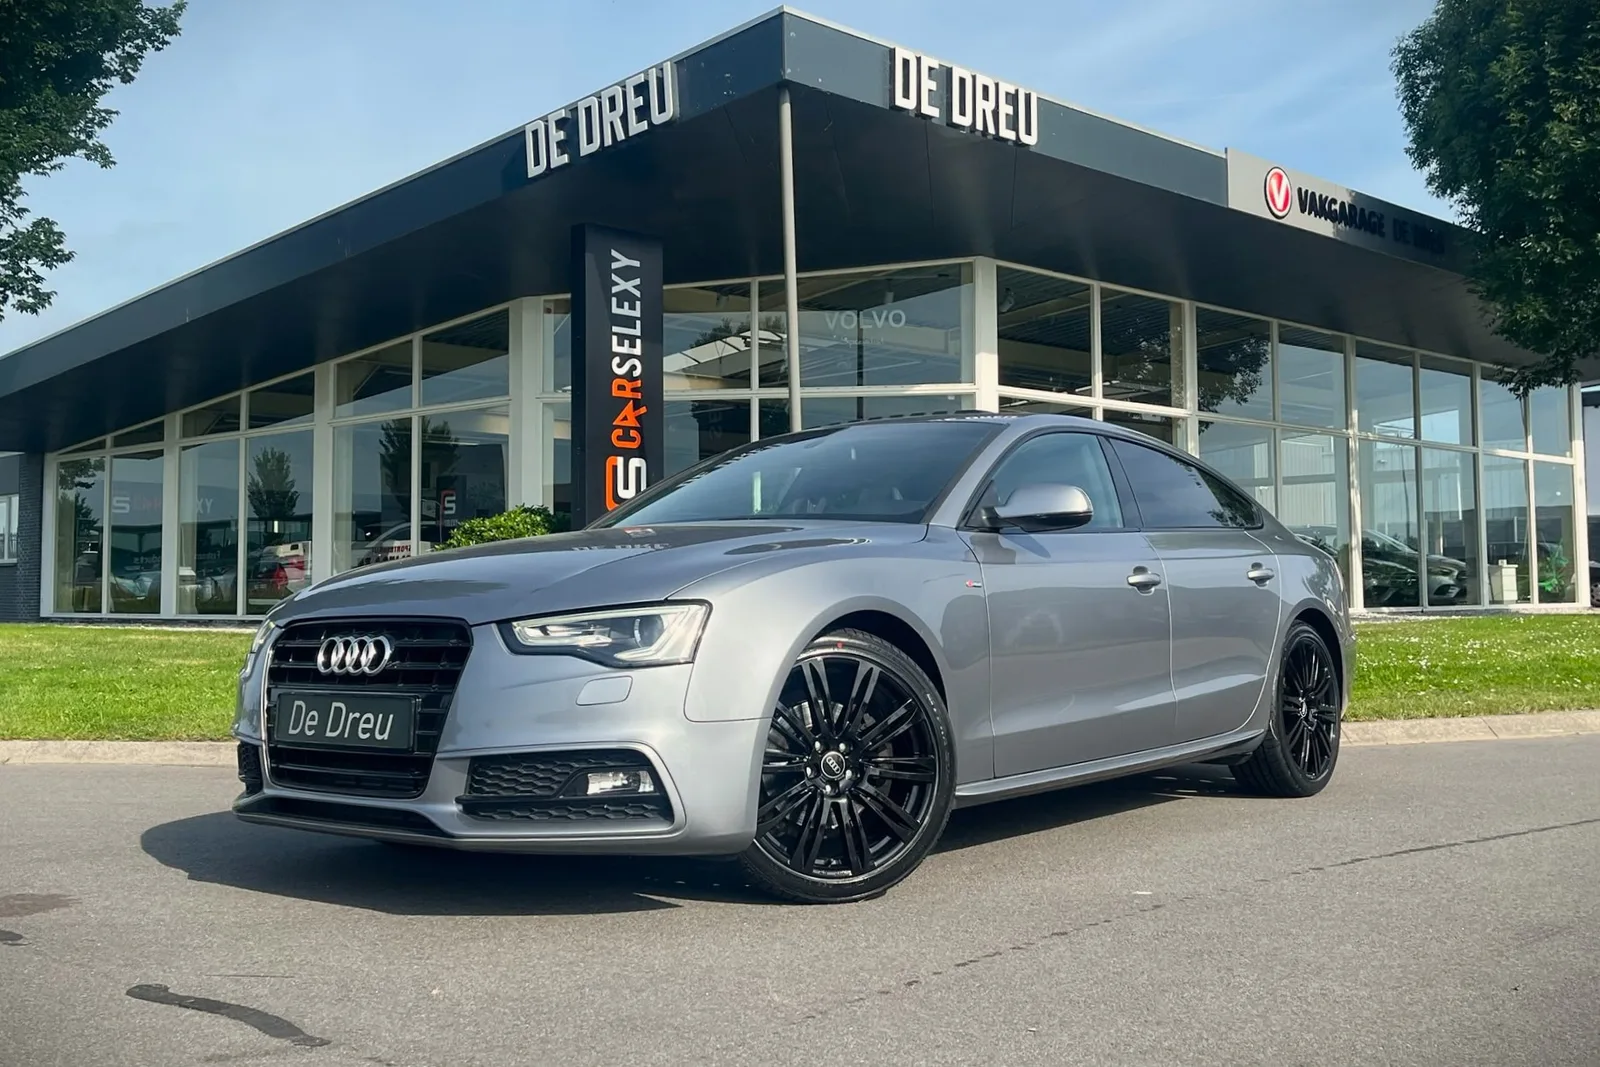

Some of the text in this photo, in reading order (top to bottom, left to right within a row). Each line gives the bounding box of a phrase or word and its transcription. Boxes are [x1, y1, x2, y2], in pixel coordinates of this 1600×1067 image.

[524, 61, 675, 179] DE DREU
[895, 46, 1038, 147] DE DREU
[1297, 186, 1386, 238] VAKGARAGE
[824, 309, 906, 331] VOLVO
[288, 700, 394, 741] De Dreu
